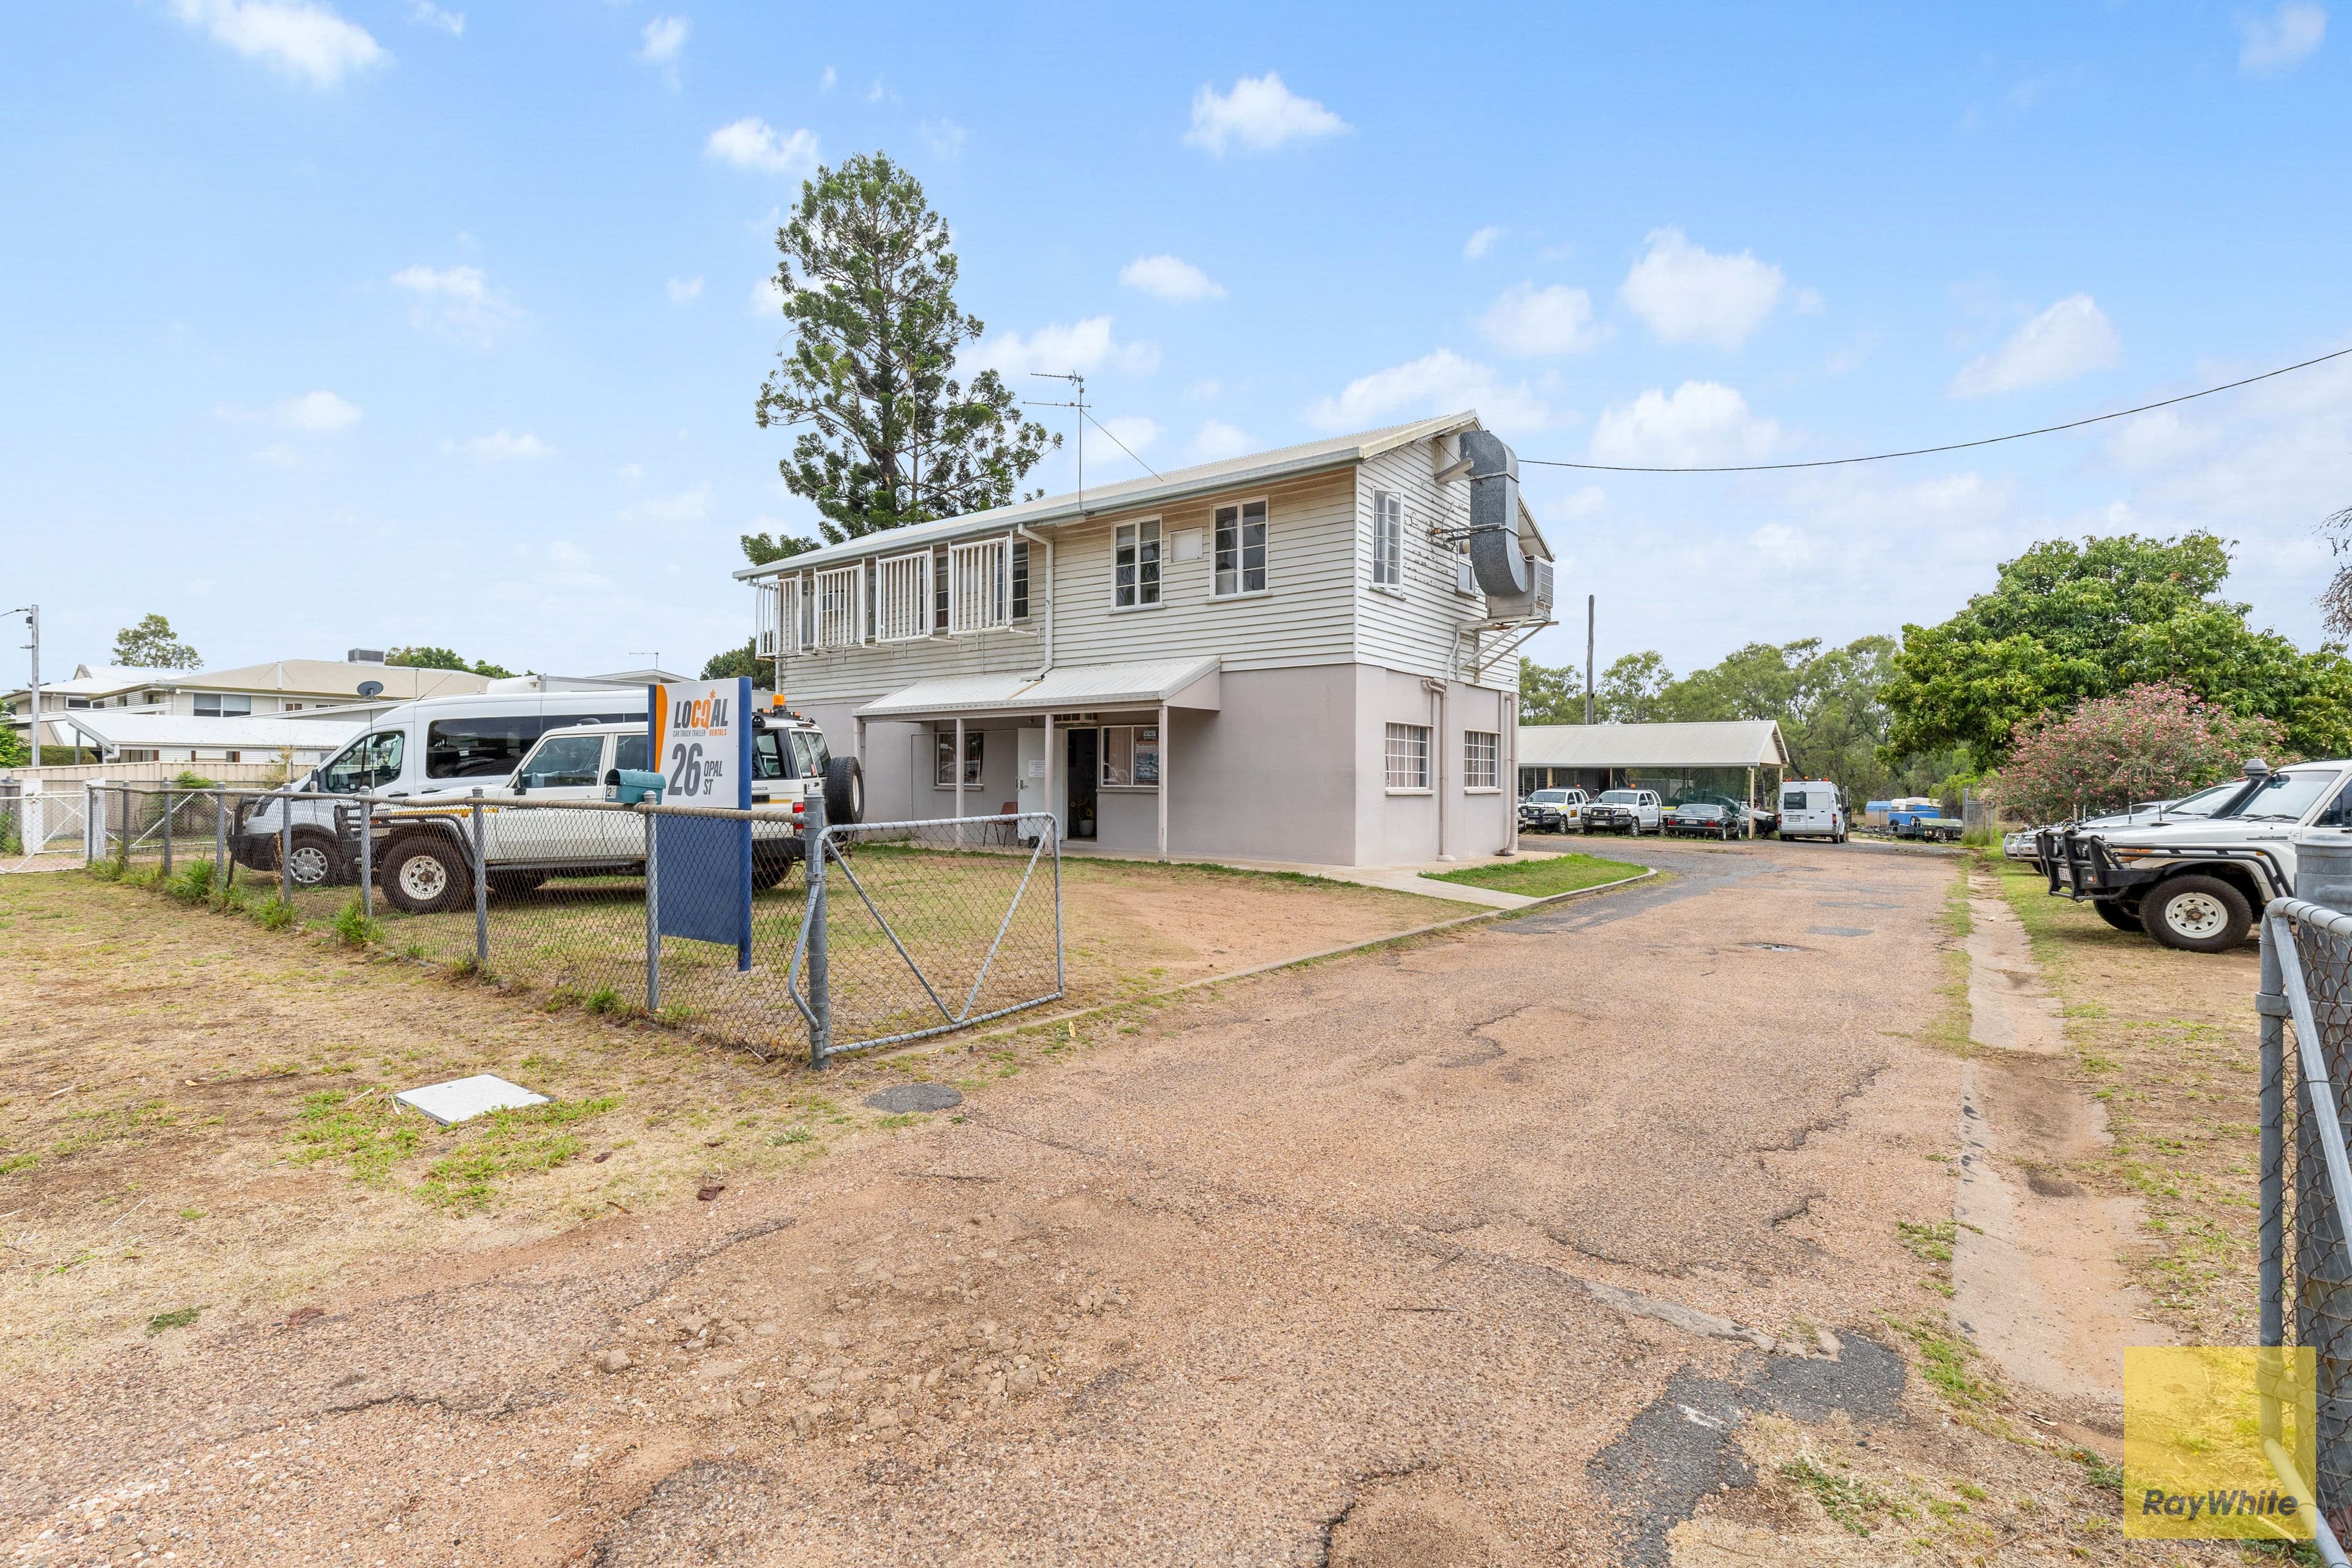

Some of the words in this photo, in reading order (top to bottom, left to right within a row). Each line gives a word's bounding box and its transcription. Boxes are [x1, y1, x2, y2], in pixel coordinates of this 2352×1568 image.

[668, 743, 703, 796] 26
[704, 760, 723, 777] OPAL
[703, 778, 714, 795] ST
